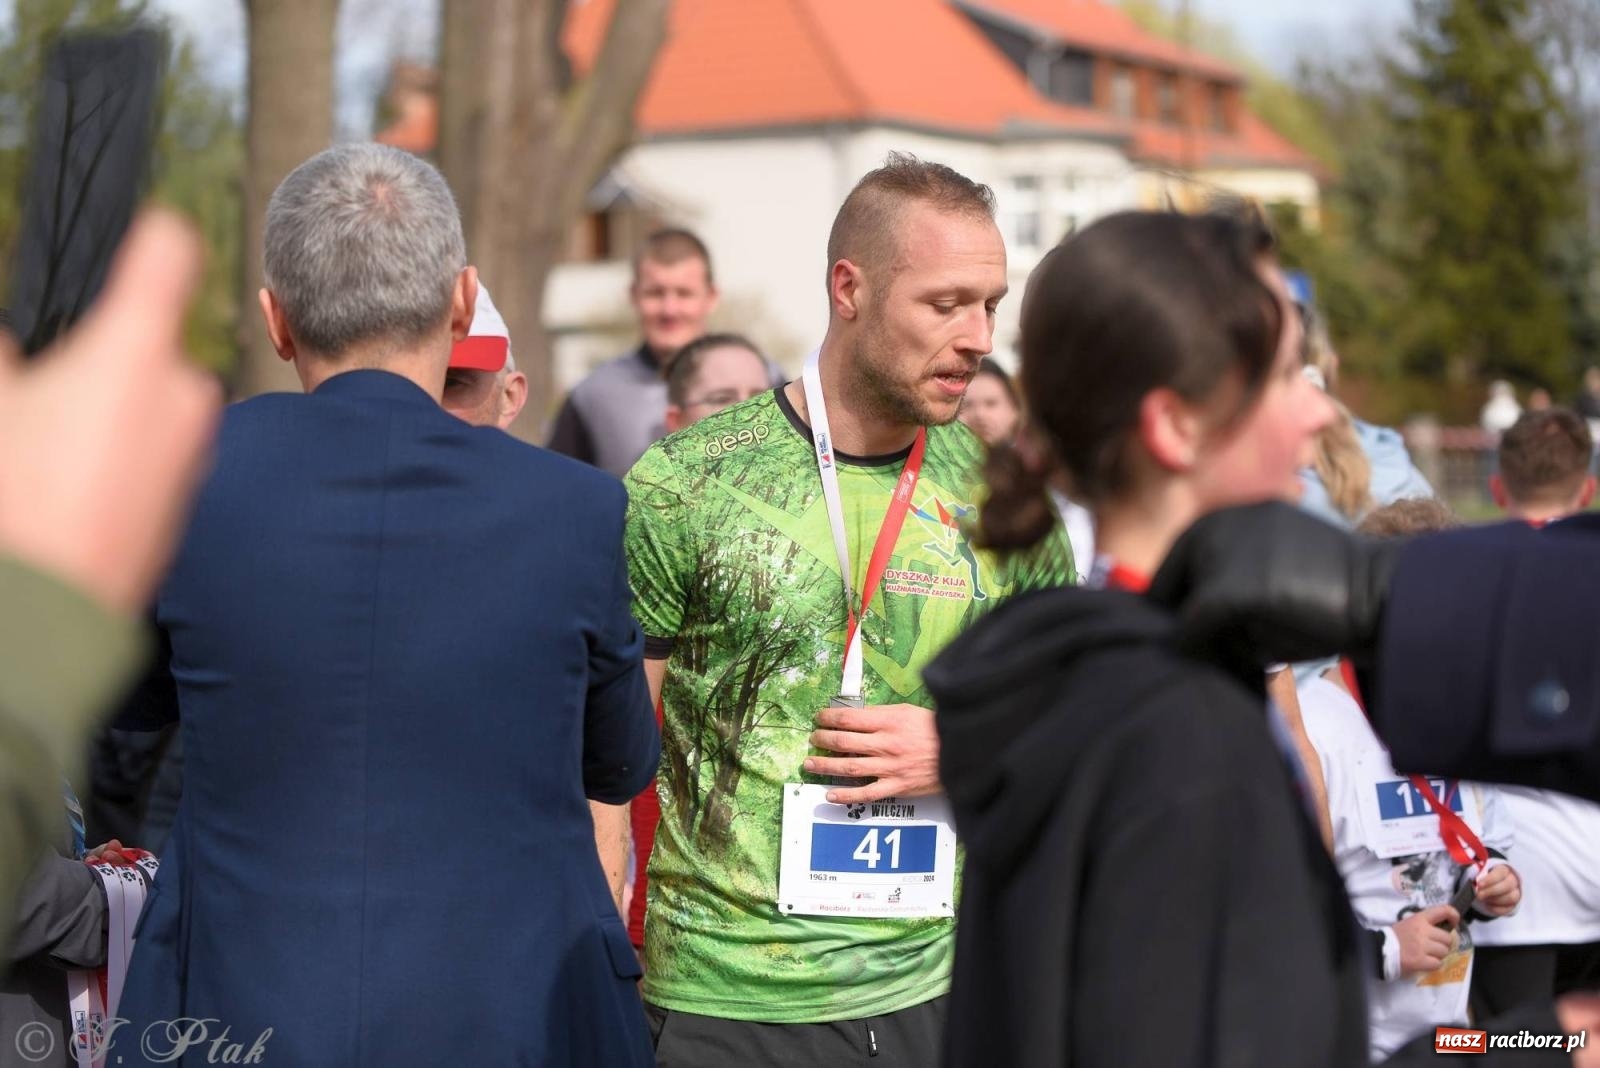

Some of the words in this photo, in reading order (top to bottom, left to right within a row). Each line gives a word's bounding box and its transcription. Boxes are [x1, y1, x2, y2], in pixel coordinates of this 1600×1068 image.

[706, 424, 770, 458] deep
[932, 575, 940, 585] Z
[942, 577, 967, 587] KIJA
[931, 588, 966, 599] ZADYSZKA
[871, 804, 915, 818] WILCZYM
[852, 828, 902, 869] 41
[809, 873, 828, 882] 1963
